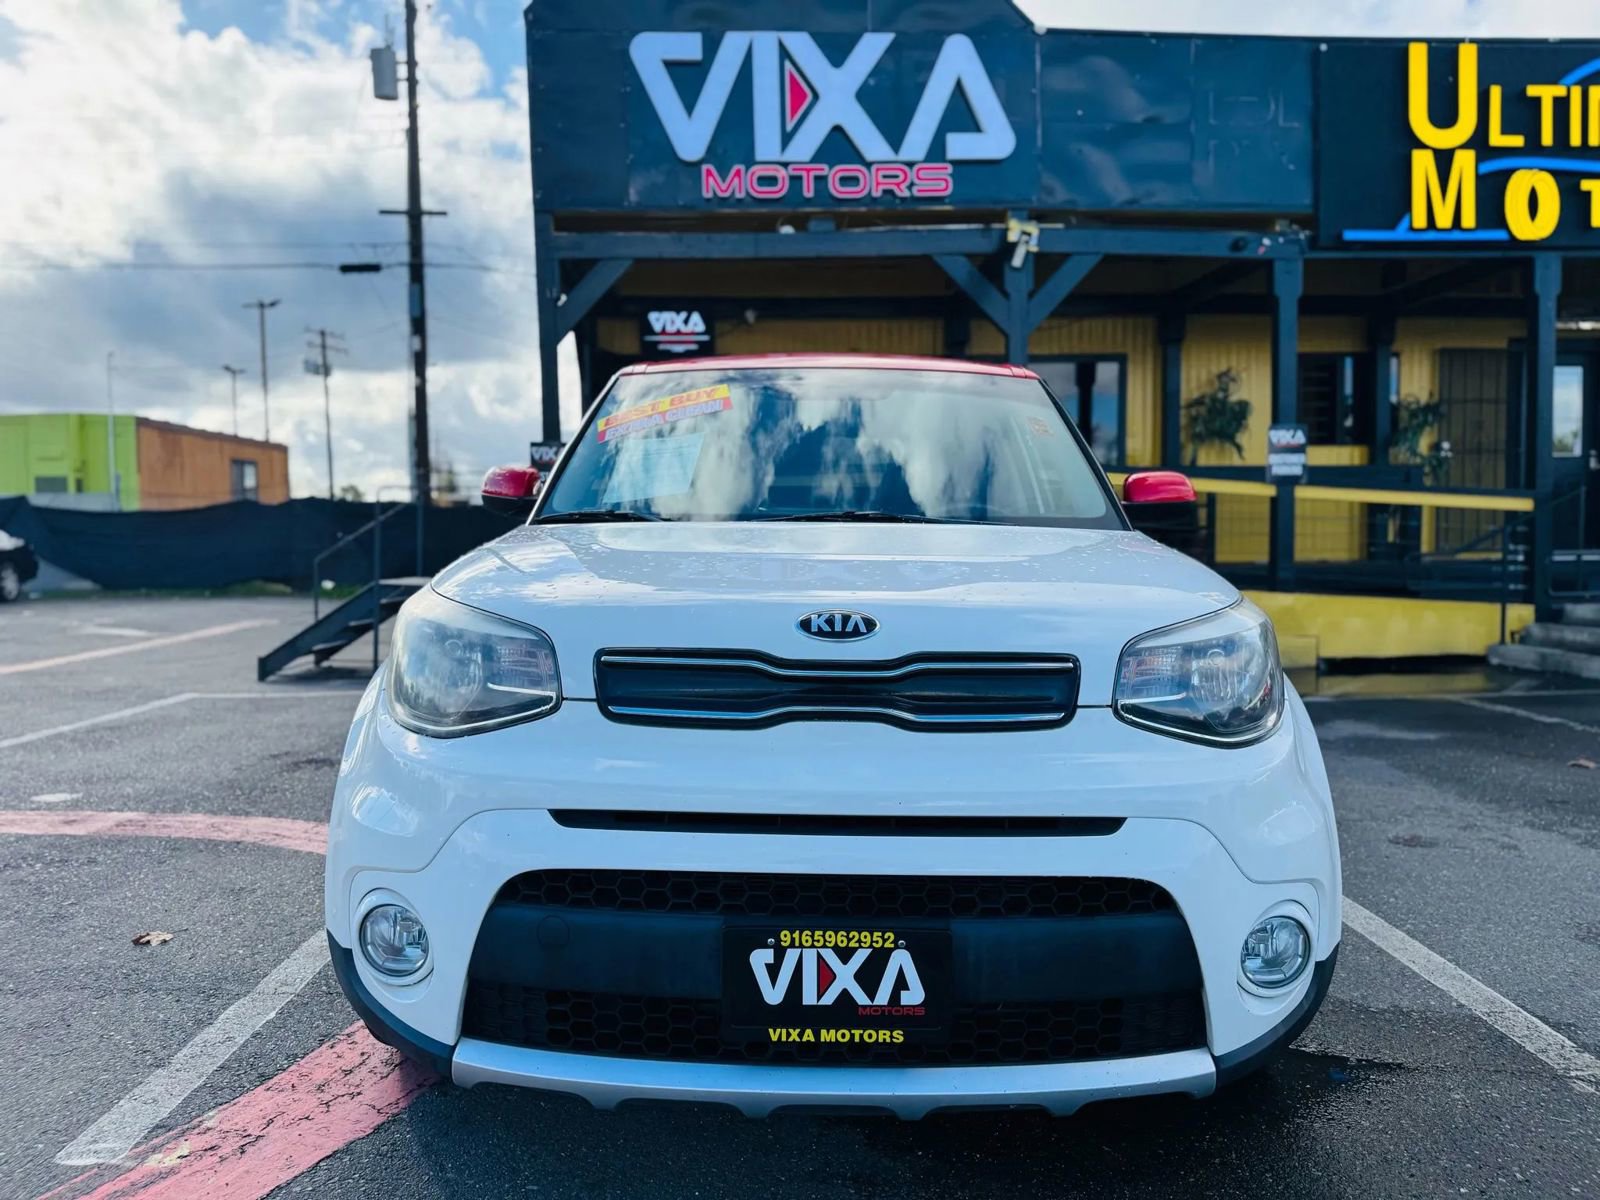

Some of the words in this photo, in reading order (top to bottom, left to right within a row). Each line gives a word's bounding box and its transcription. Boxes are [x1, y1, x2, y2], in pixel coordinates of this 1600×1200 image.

[629, 30, 1017, 162] VIXA
[1408, 42, 1600, 149] ULTI
[701, 163, 954, 199] MOTORS
[647, 311, 706, 333] VIXA
[1269, 429, 1306, 445] VIXA
[810, 613, 867, 633] KIA
[780, 930, 895, 948] 9165962952
[750, 948, 926, 1006] VIXA
[858, 1007, 926, 1016] MOTORS
[768, 1028, 815, 1042] VIXA
[820, 1029, 904, 1043] MOTORS
